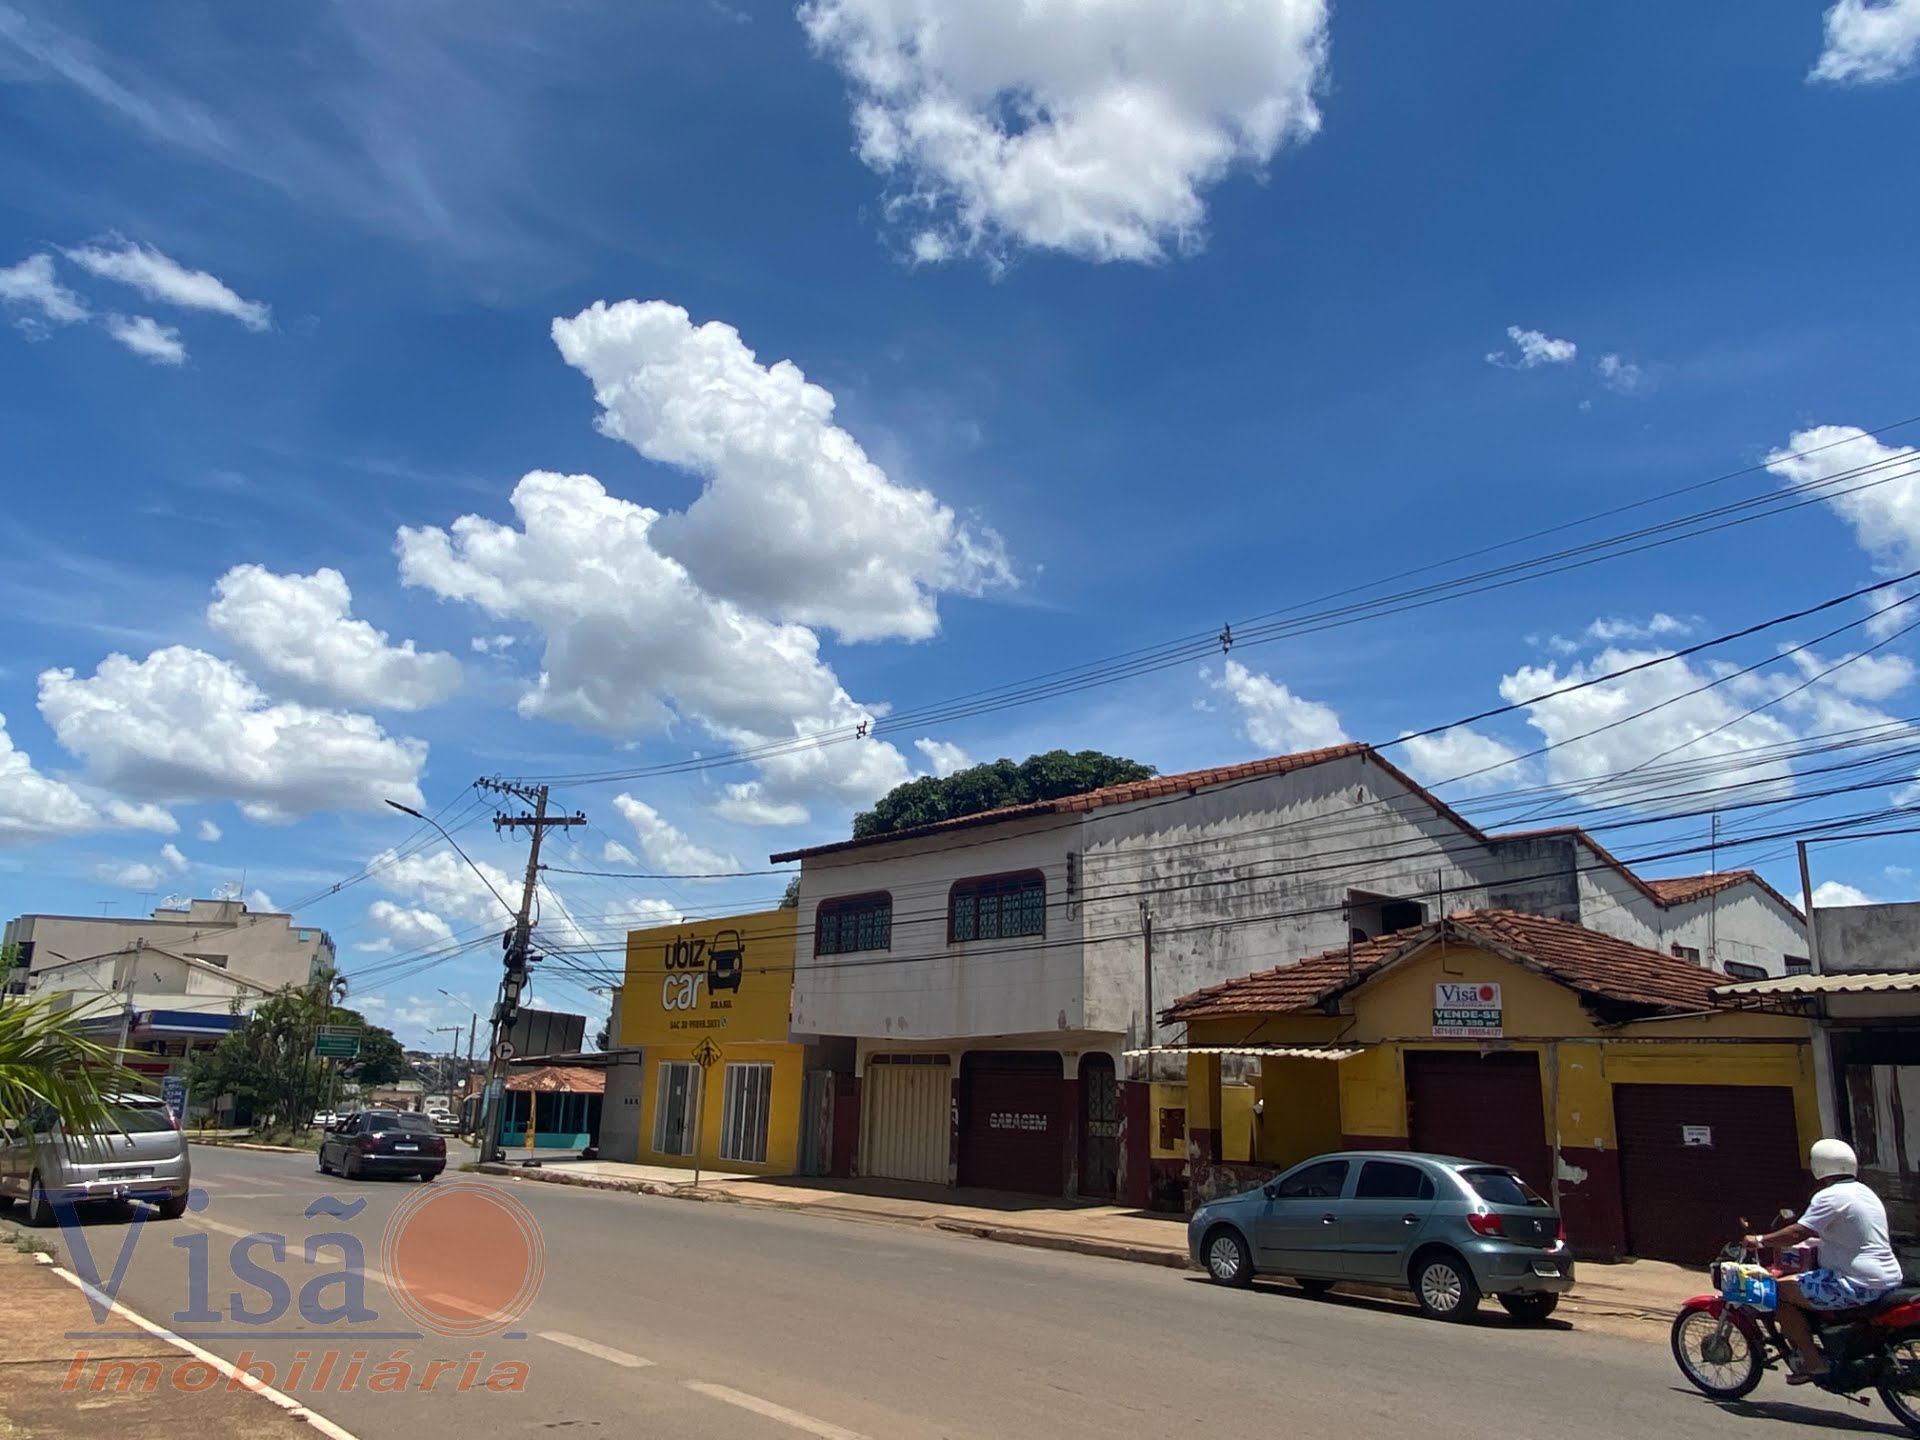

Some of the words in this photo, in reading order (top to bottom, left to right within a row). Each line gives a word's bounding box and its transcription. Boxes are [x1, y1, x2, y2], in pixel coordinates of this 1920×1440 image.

[665, 932, 705, 969] ubiz
[662, 972, 704, 1011] car
[1434, 1010, 1499, 1019] VENDE-SE
[990, 1112, 1047, 1131] GARAGEM
